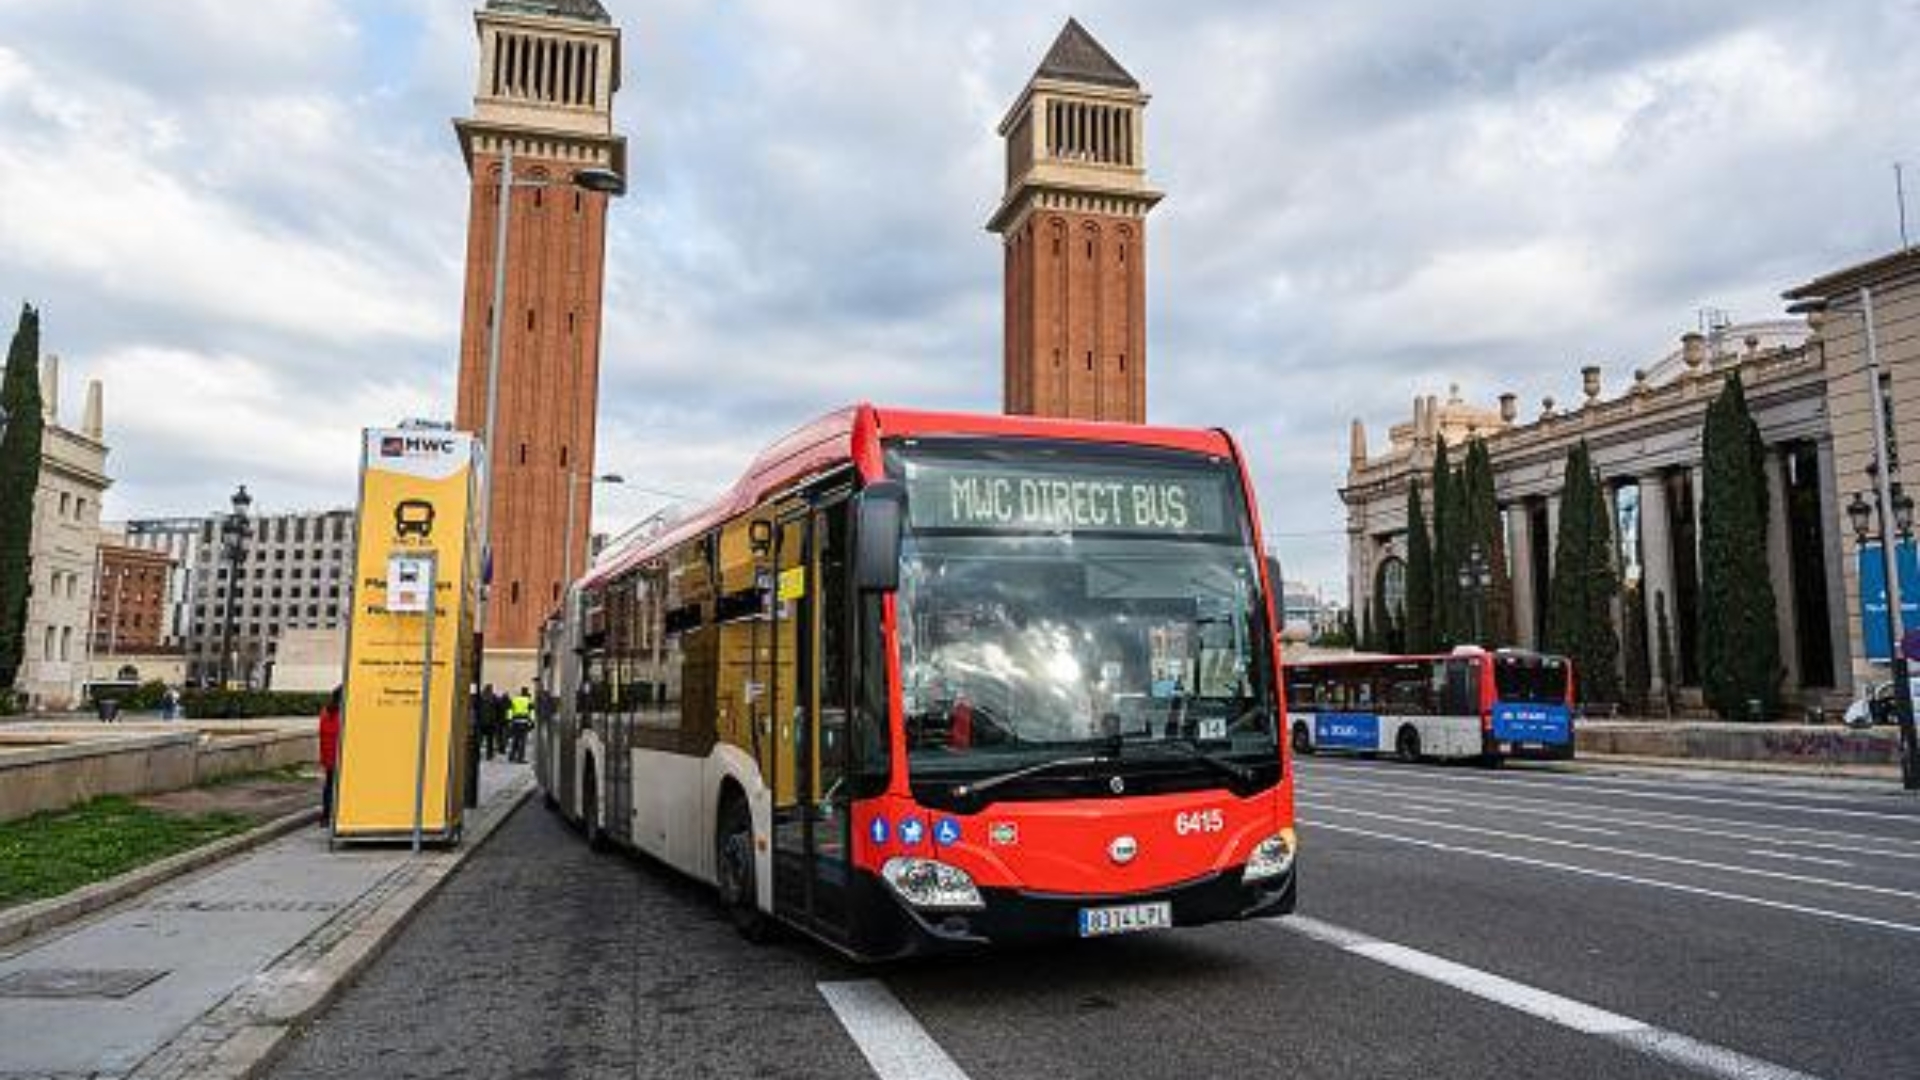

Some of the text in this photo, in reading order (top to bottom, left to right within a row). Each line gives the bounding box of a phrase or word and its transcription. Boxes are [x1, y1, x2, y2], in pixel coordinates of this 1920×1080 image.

[950, 475, 1188, 528] MWC DIRECT BUS
[1175, 808, 1223, 835] 6415
